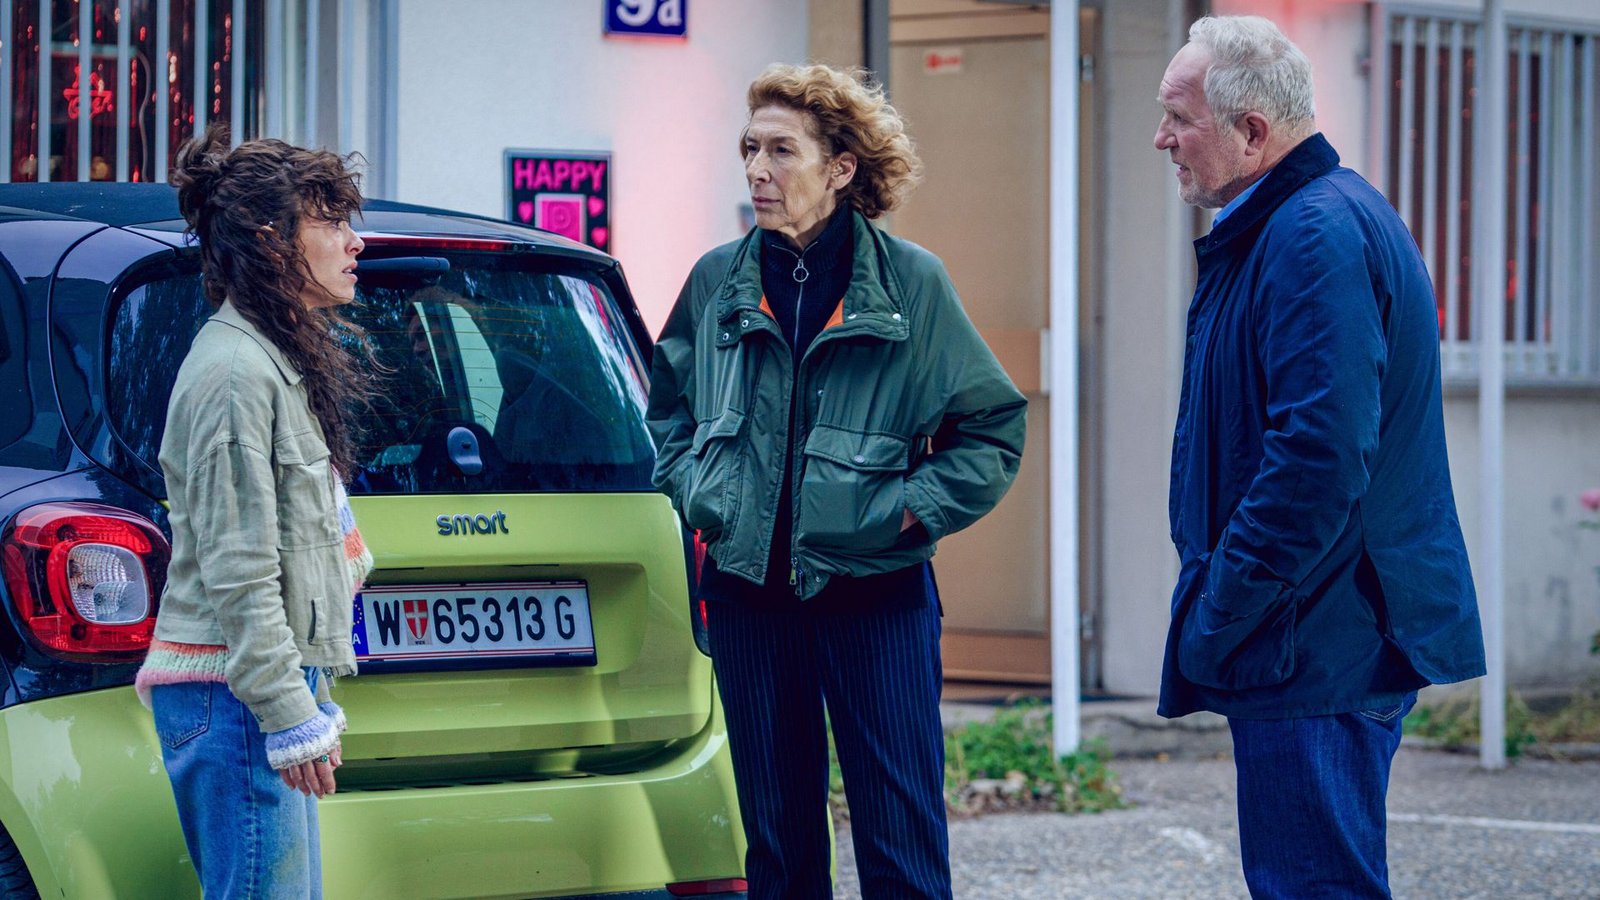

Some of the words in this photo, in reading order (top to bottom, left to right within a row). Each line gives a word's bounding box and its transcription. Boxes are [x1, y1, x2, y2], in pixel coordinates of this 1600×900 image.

[513, 158, 607, 192] HAPPY
[436, 510, 509, 536] smart
[372, 599, 400, 646] W
[432, 595, 546, 644] 65313
[554, 595, 576, 640] G
